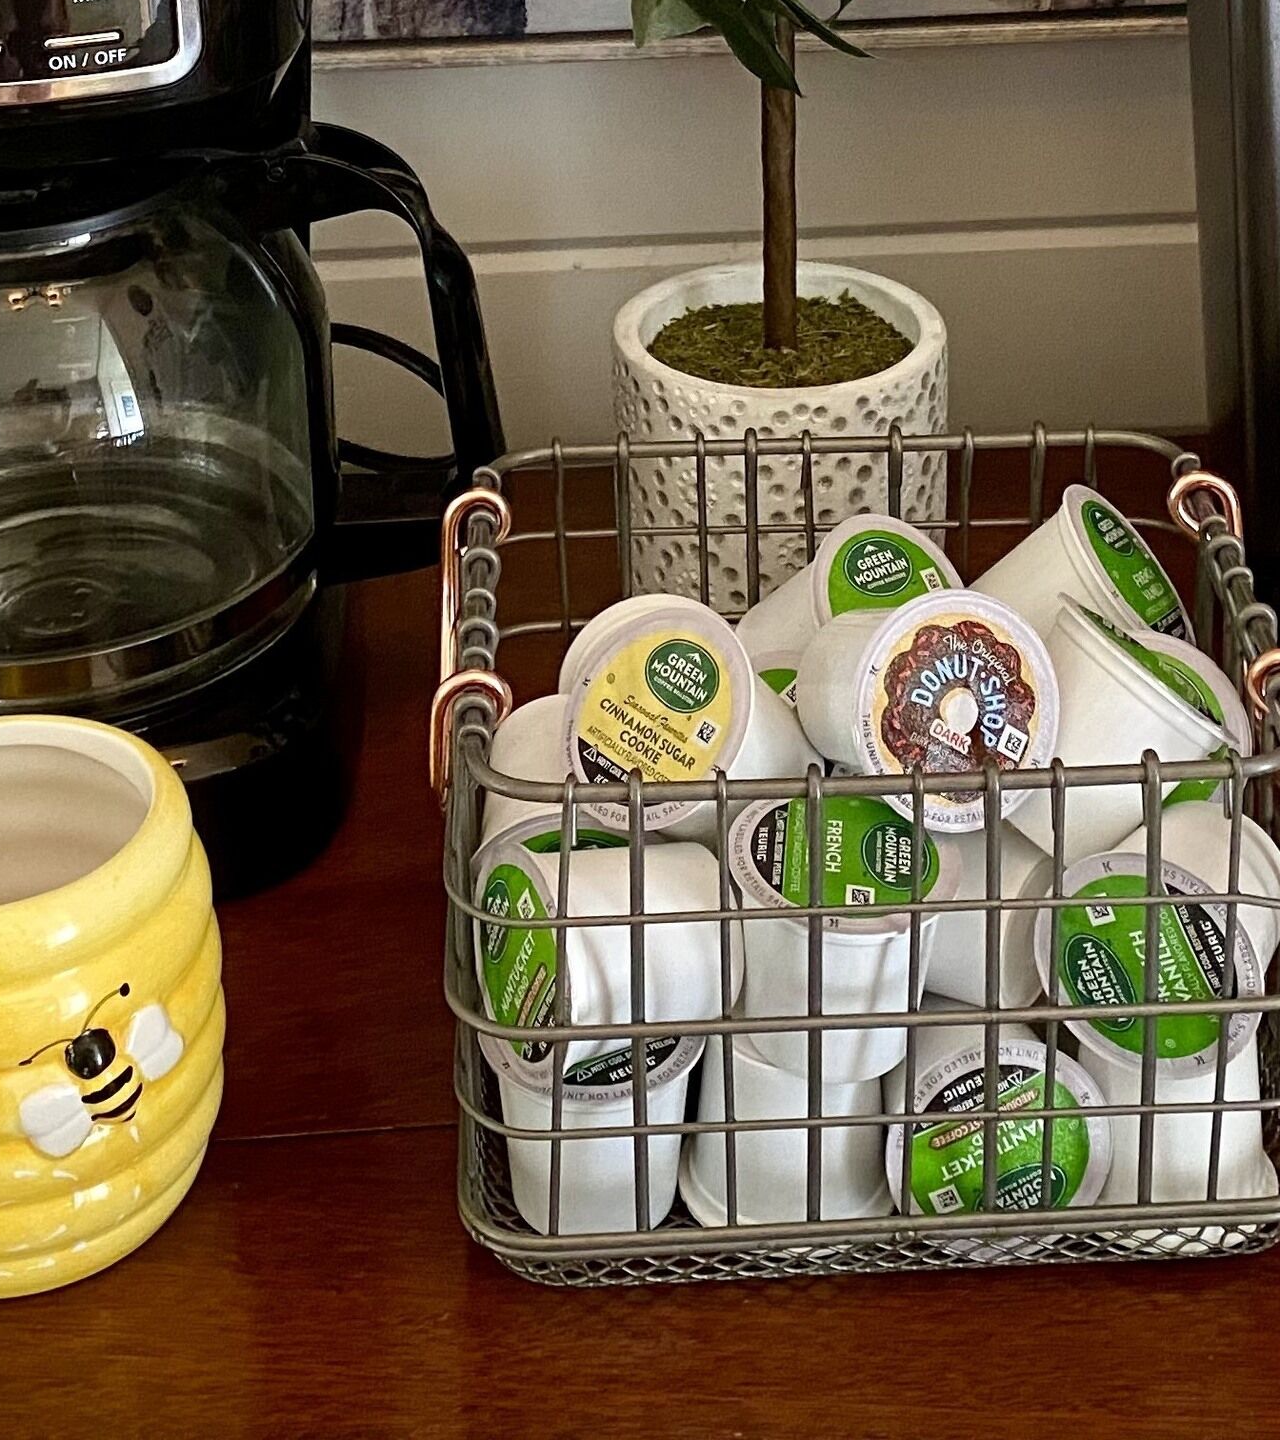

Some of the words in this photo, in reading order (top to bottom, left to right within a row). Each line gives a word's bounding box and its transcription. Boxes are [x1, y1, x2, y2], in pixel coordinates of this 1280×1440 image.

[48, 53, 77, 71] ON
[94, 48, 128, 65] OFF
[854, 558, 909, 586] MOUNTAIN
[857, 549, 894, 570] GREEN
[668, 653, 708, 684] GREEN
[942, 634, 969, 651] The
[971, 639, 1017, 687] Original
[651, 659, 708, 704] MOUNTAIN
[911, 653, 986, 709] DONUT
[980, 676, 1007, 748] SHOP
[599, 698, 662, 747] CINNAMON
[660, 738, 696, 771] SUGAR
[619, 730, 662, 765] COOKIE
[933, 722, 969, 750] DARK
[953, 811, 984, 825] RETAI
[756, 827, 768, 862] KEURIG
[825, 820, 844, 873] FRENCH
[883, 826, 897, 883] MOUNTAIN
[898, 837, 911, 875] GREEN
[1199, 918, 1225, 971] EURIG
[500, 931, 535, 1015] NANTUCKET
[609, 1056, 656, 1082] KEUG
[944, 1049, 983, 1073] ABELED
[588, 1090, 609, 1101] NOT
[925, 1073, 944, 1090] FOR
[933, 1126, 968, 1148] COFFEE
[971, 1119, 1016, 1147] BLD
[941, 1118, 1044, 1182] ANTCKET
